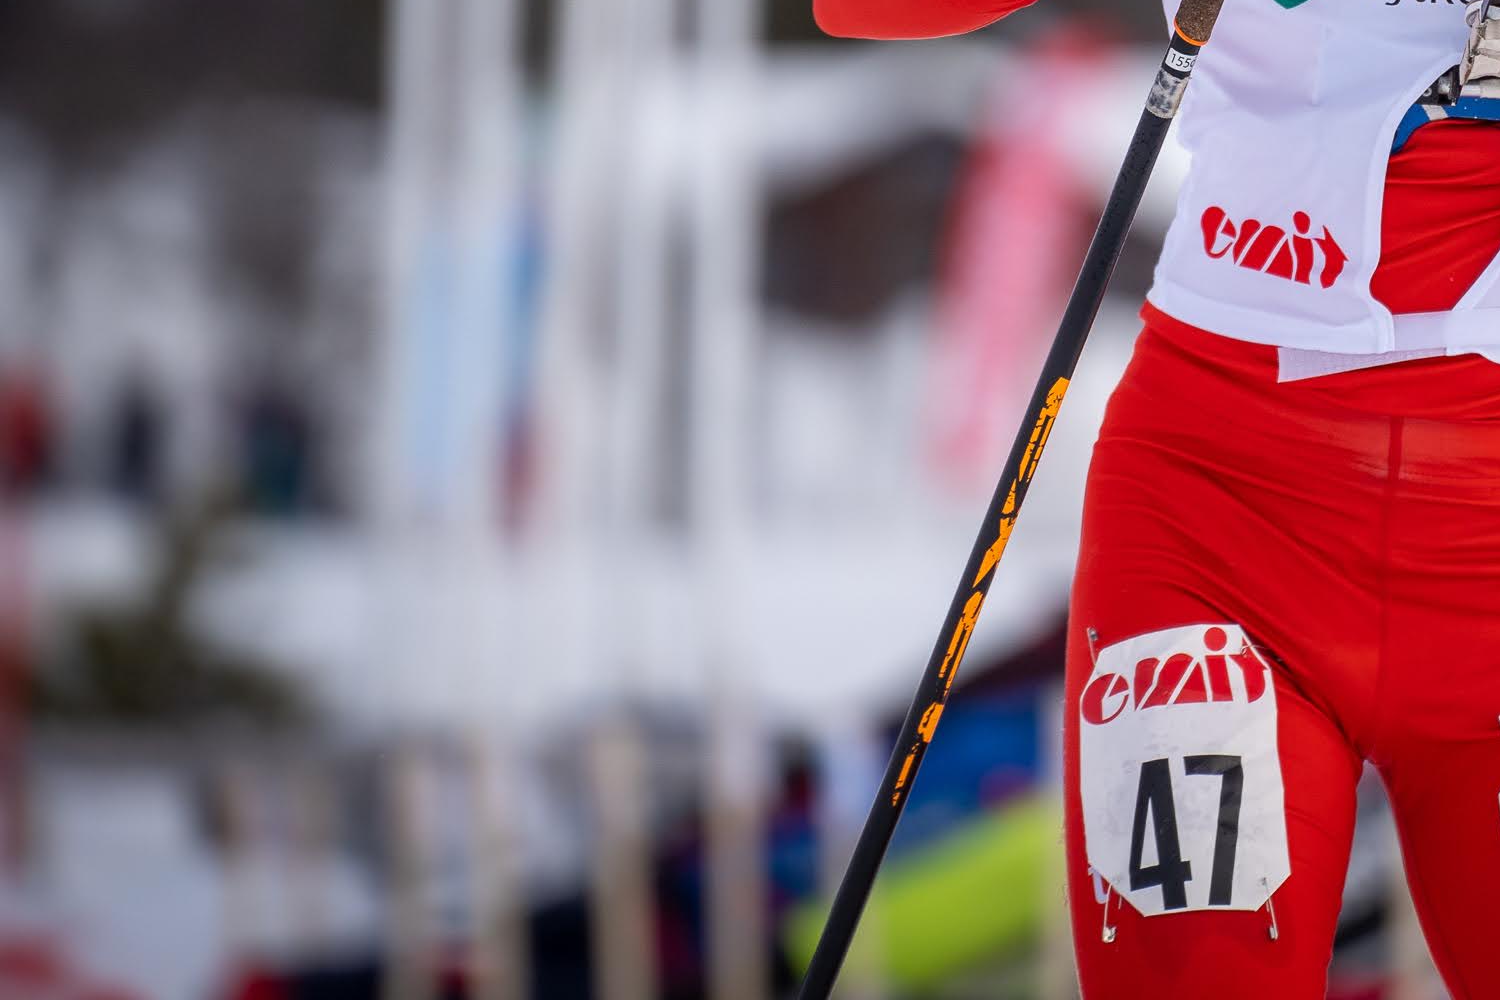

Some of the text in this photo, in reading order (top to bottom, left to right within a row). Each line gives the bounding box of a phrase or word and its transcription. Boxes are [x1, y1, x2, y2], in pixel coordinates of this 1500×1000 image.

[1200, 206, 1350, 289] emit
[1080, 626, 1270, 725] emit
[1129, 754, 1244, 911] 47
